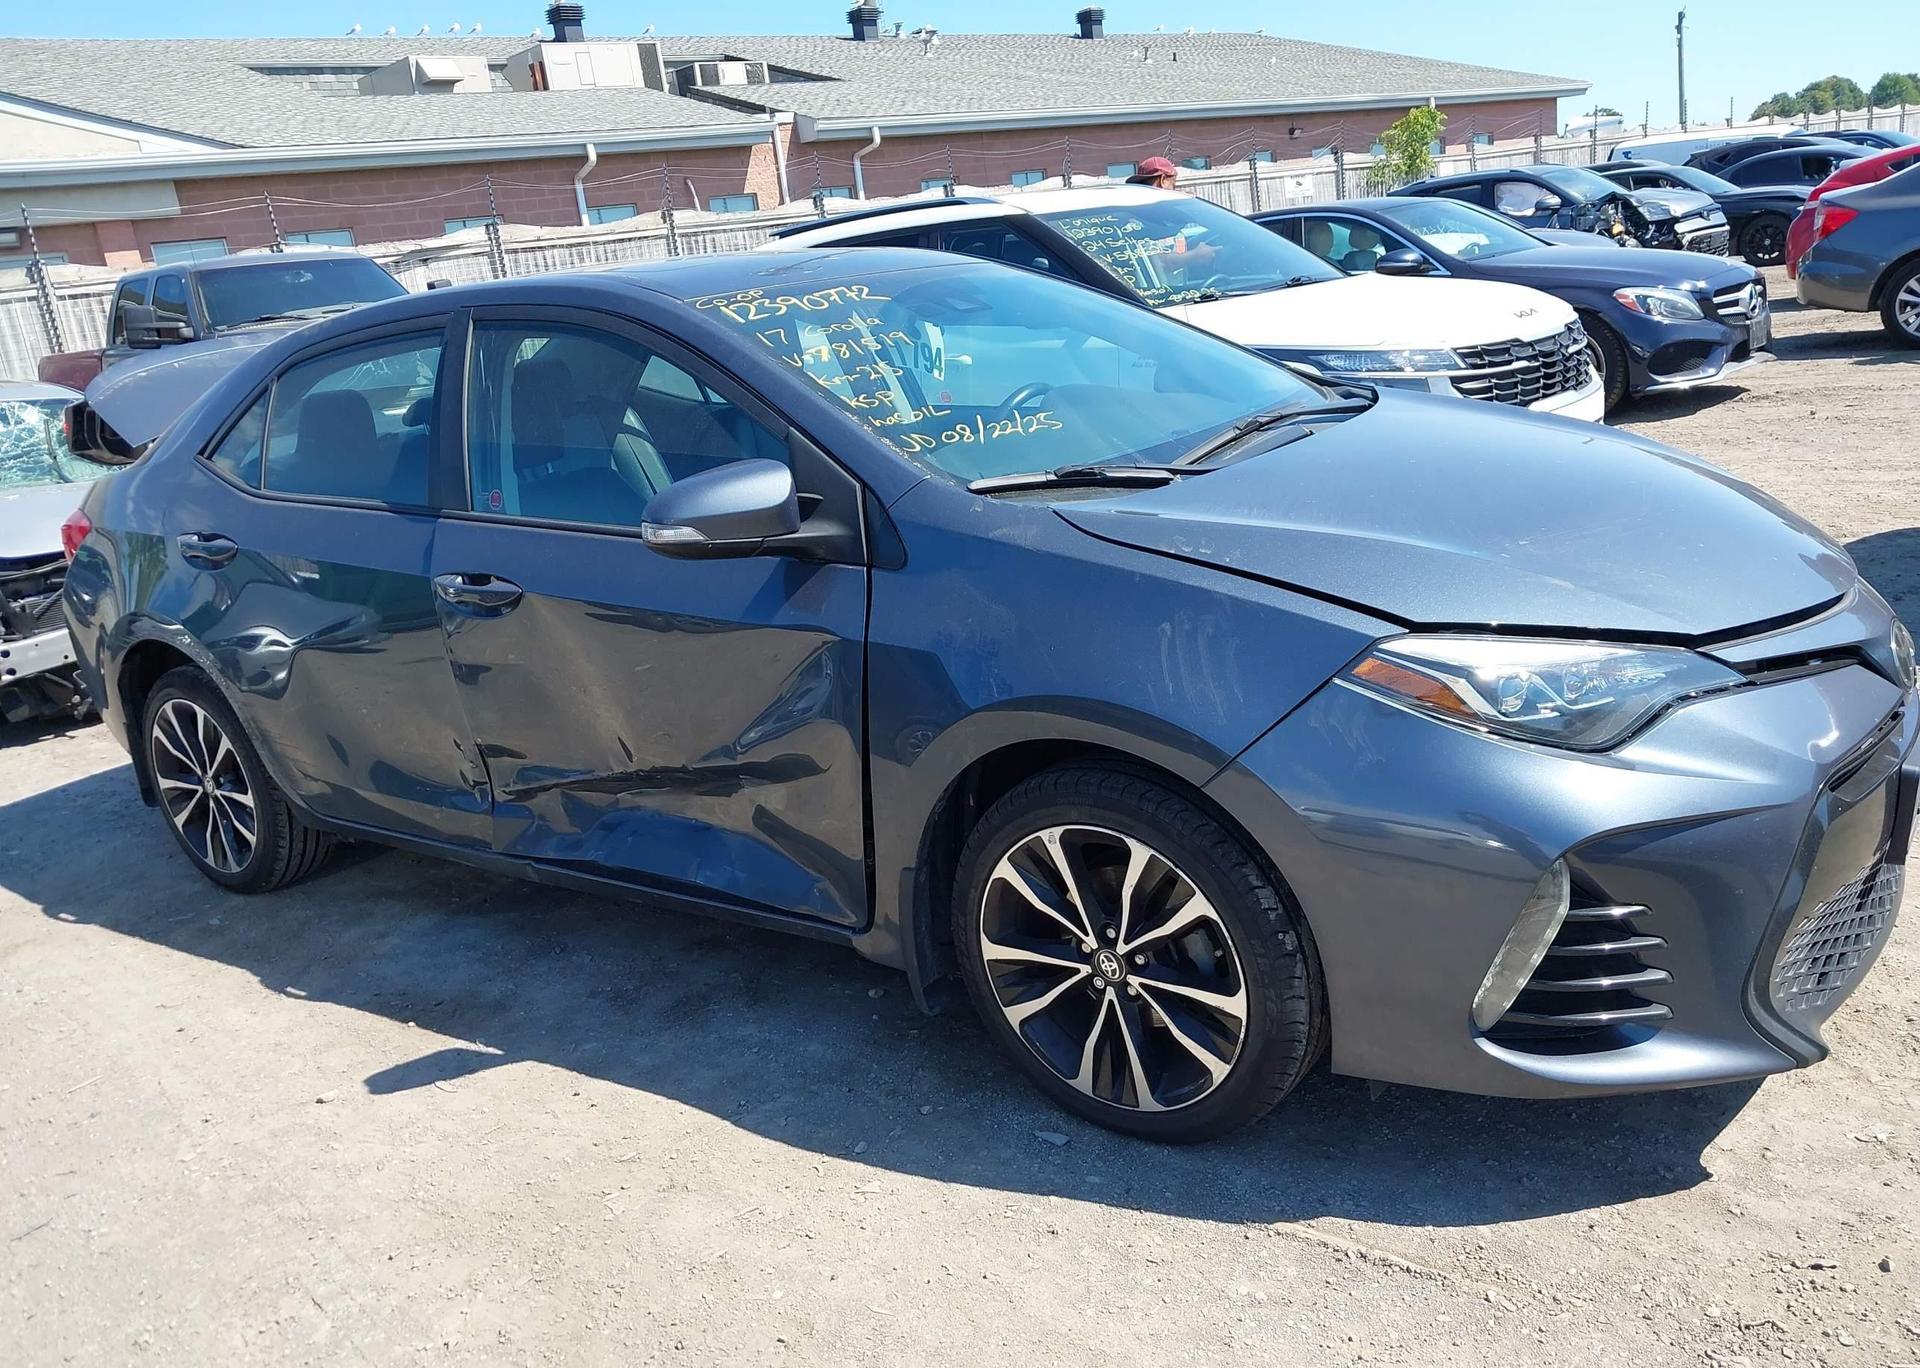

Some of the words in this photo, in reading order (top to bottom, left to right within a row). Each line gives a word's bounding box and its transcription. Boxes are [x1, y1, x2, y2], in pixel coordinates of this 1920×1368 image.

[719, 284, 893, 324] 12390772
[755, 328, 789, 348] 17
[804, 314, 885, 338] Corolla
[940, 409, 1063, 445] 08/22/25
